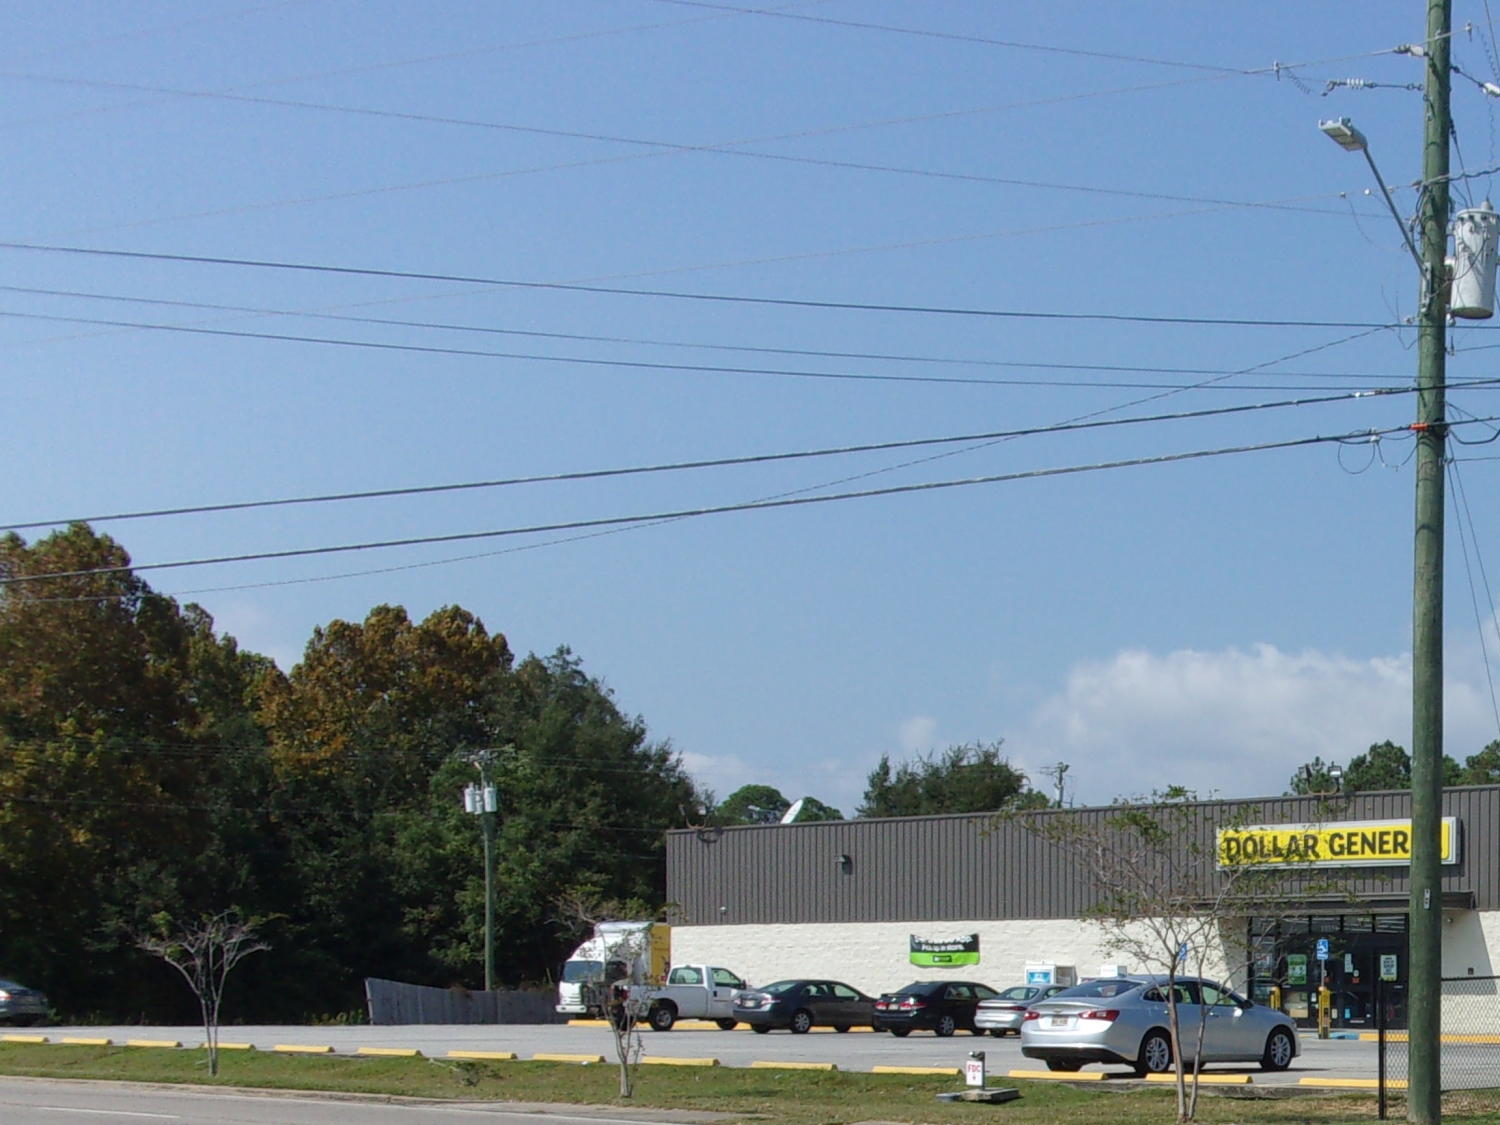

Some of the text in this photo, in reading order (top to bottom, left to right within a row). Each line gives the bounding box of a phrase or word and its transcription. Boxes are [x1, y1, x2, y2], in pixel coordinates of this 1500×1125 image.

[1225, 831, 1430, 861] DOLLAR GENER
[968, 1064, 981, 1072] FDC
